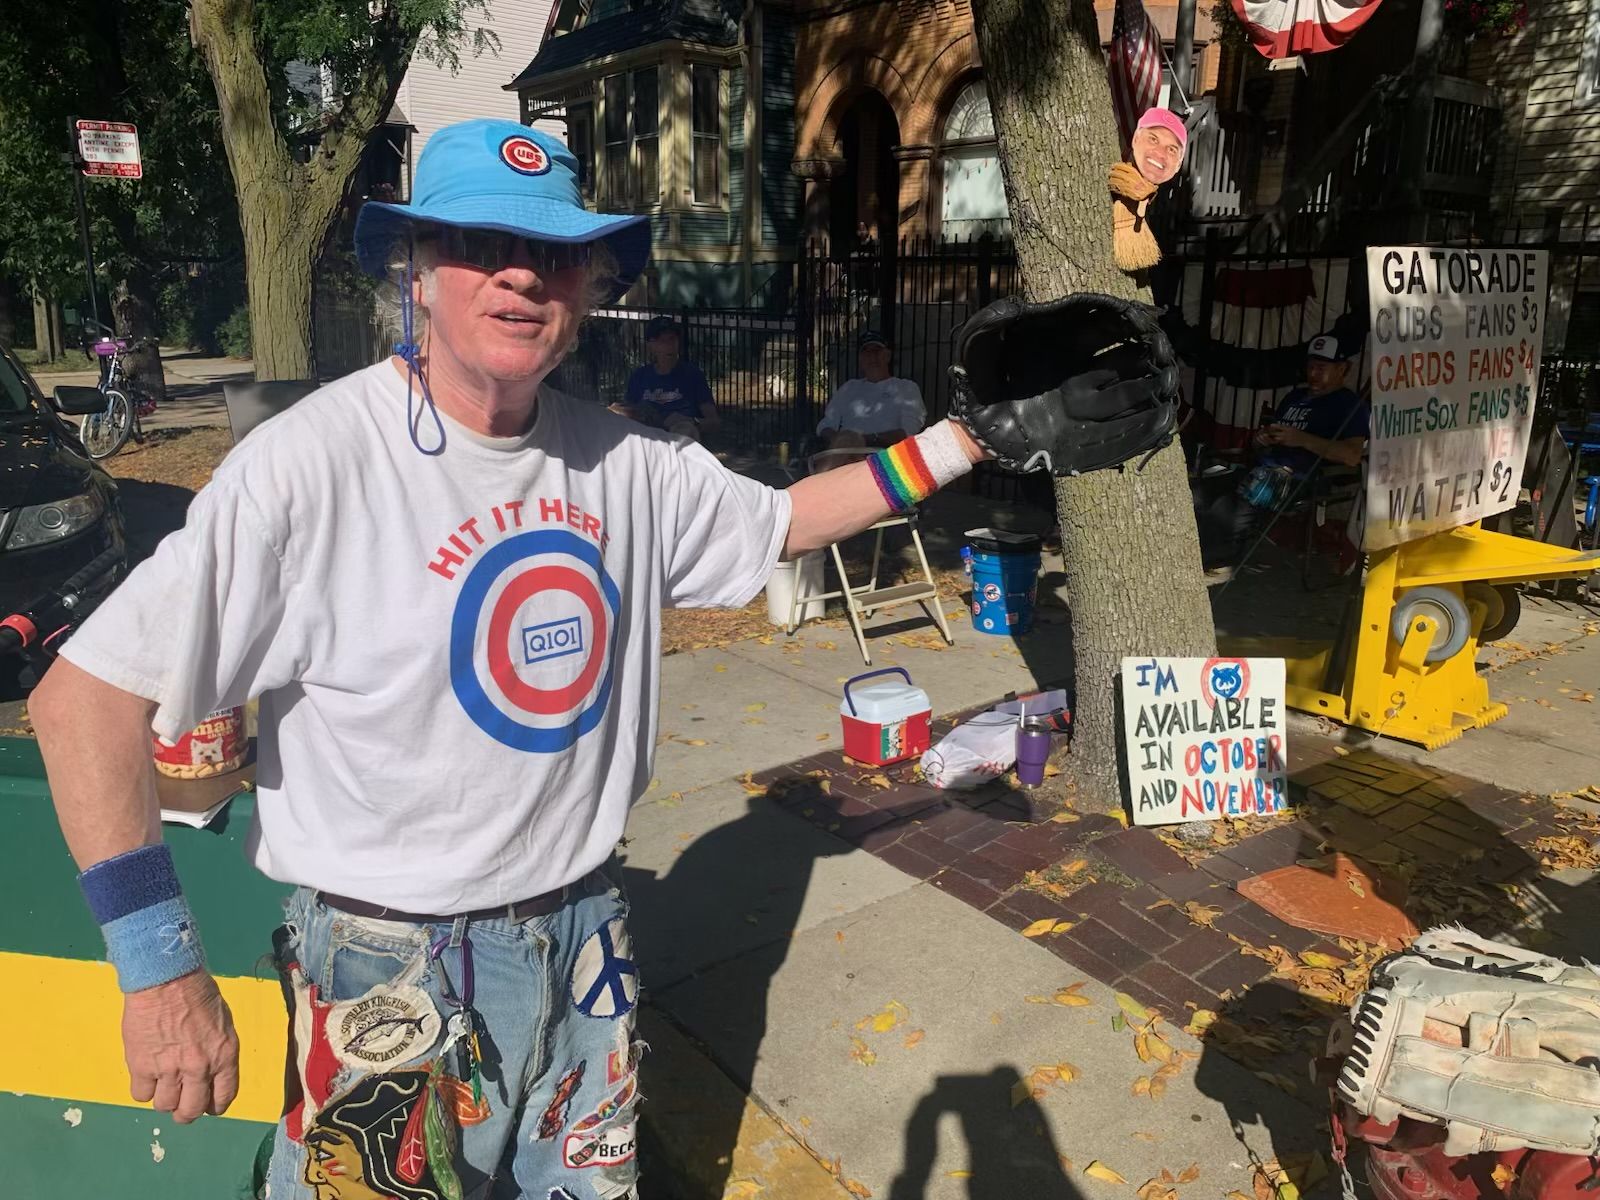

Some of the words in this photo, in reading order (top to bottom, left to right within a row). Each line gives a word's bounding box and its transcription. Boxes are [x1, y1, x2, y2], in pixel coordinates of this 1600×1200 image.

[106, 124, 132, 132] PARKING
[1382, 251, 1536, 294] GATORADE
[1375, 305, 1443, 344] CUBS
[1465, 303, 1515, 339] FANS
[1521, 296, 1538, 334] $3
[1376, 351, 1456, 392] CARDS
[1468, 346, 1514, 382] FANS
[1518, 338, 1534, 375] $4
[1467, 388, 1511, 425] FANS
[1514, 383, 1530, 417] $5
[1388, 468, 1484, 530] WATER
[1490, 460, 1512, 503] $2
[427, 517, 485, 581] HIT
[491, 501, 524, 533] IT
[539, 497, 611, 555] HERE
[1135, 658, 1179, 696] I'M
[1135, 696, 1277, 738] AVAILABLE
[1140, 740, 1173, 771] IN
[1184, 734, 1282, 777] OCTOBER
[1139, 778, 1177, 812] AND
[1181, 776, 1285, 818] NOVEMBER
[341, 1000, 371, 1034] SOUTHERN
[371, 995, 411, 1012] KINGFISH
[351, 1040, 410, 1062] ASSOCIATION
